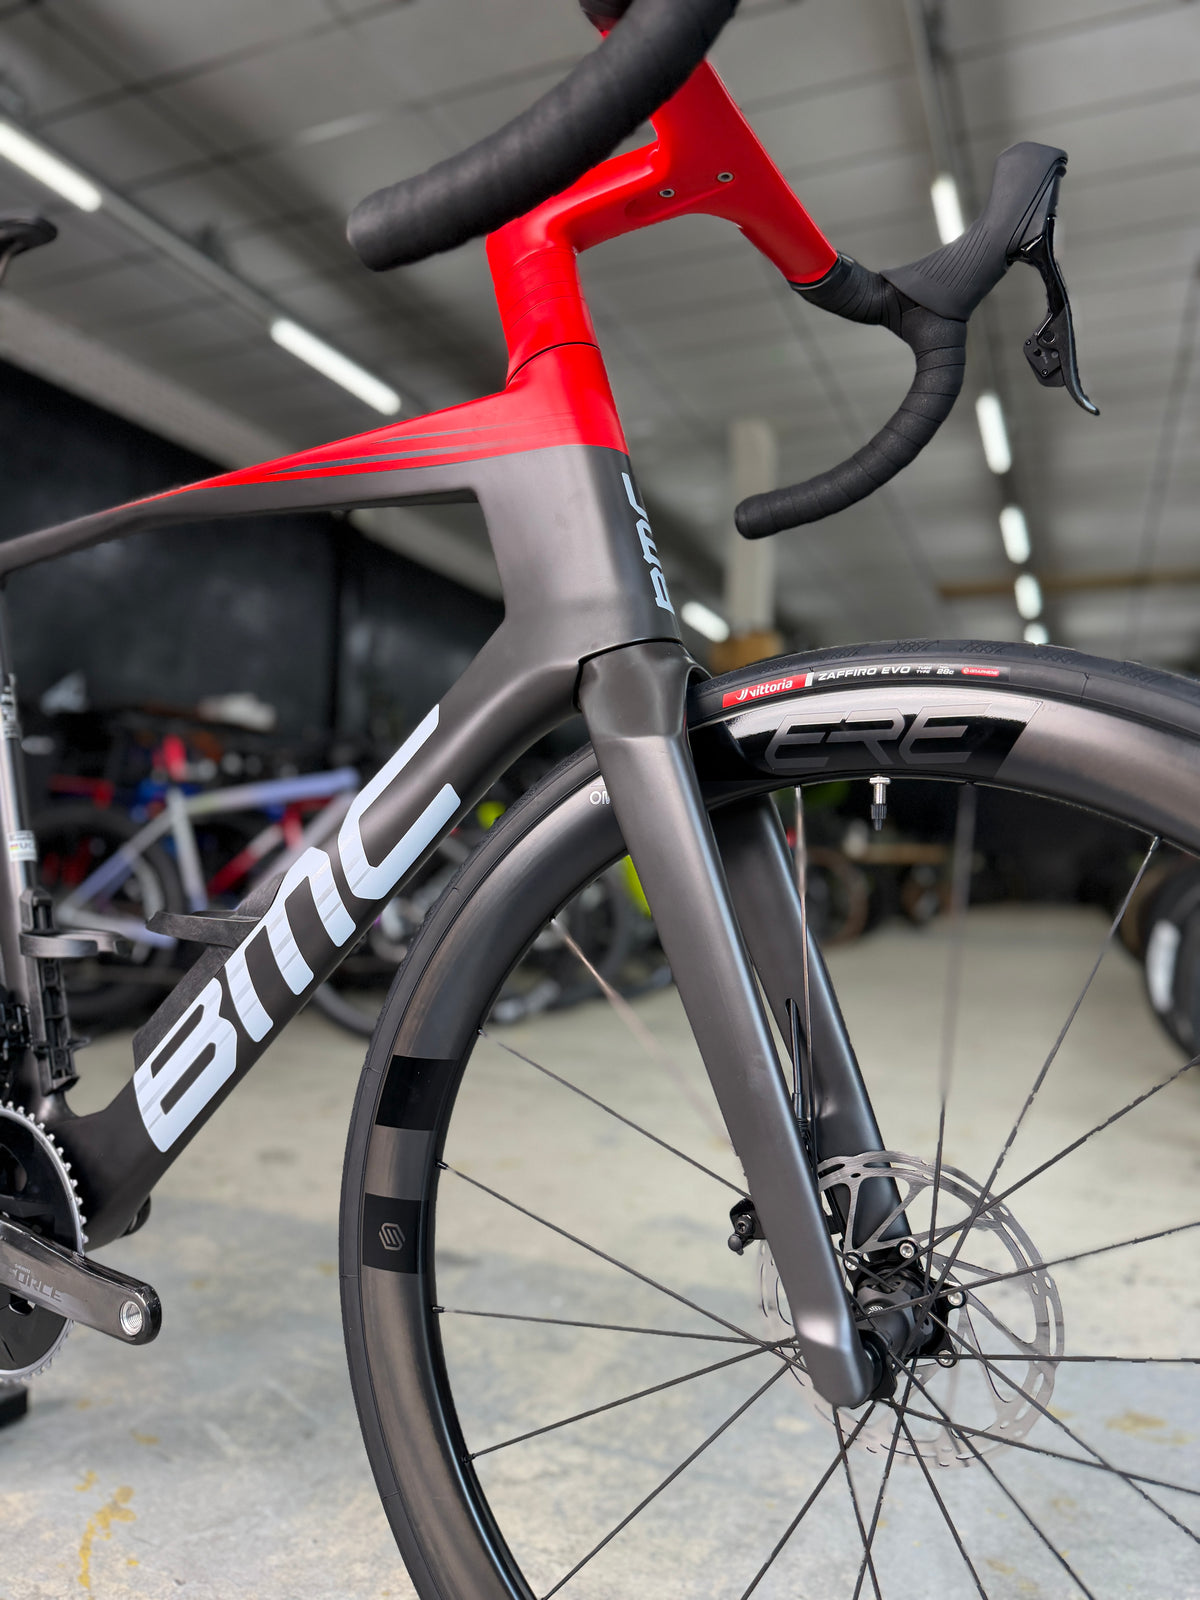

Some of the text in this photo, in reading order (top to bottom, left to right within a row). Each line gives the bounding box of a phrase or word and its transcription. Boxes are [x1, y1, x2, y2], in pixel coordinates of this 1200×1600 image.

[749, 665, 911, 698] vittoria ZAFFIRO EVO
[765, 702, 992, 769] ERE
[133, 704, 461, 1152] BMC
